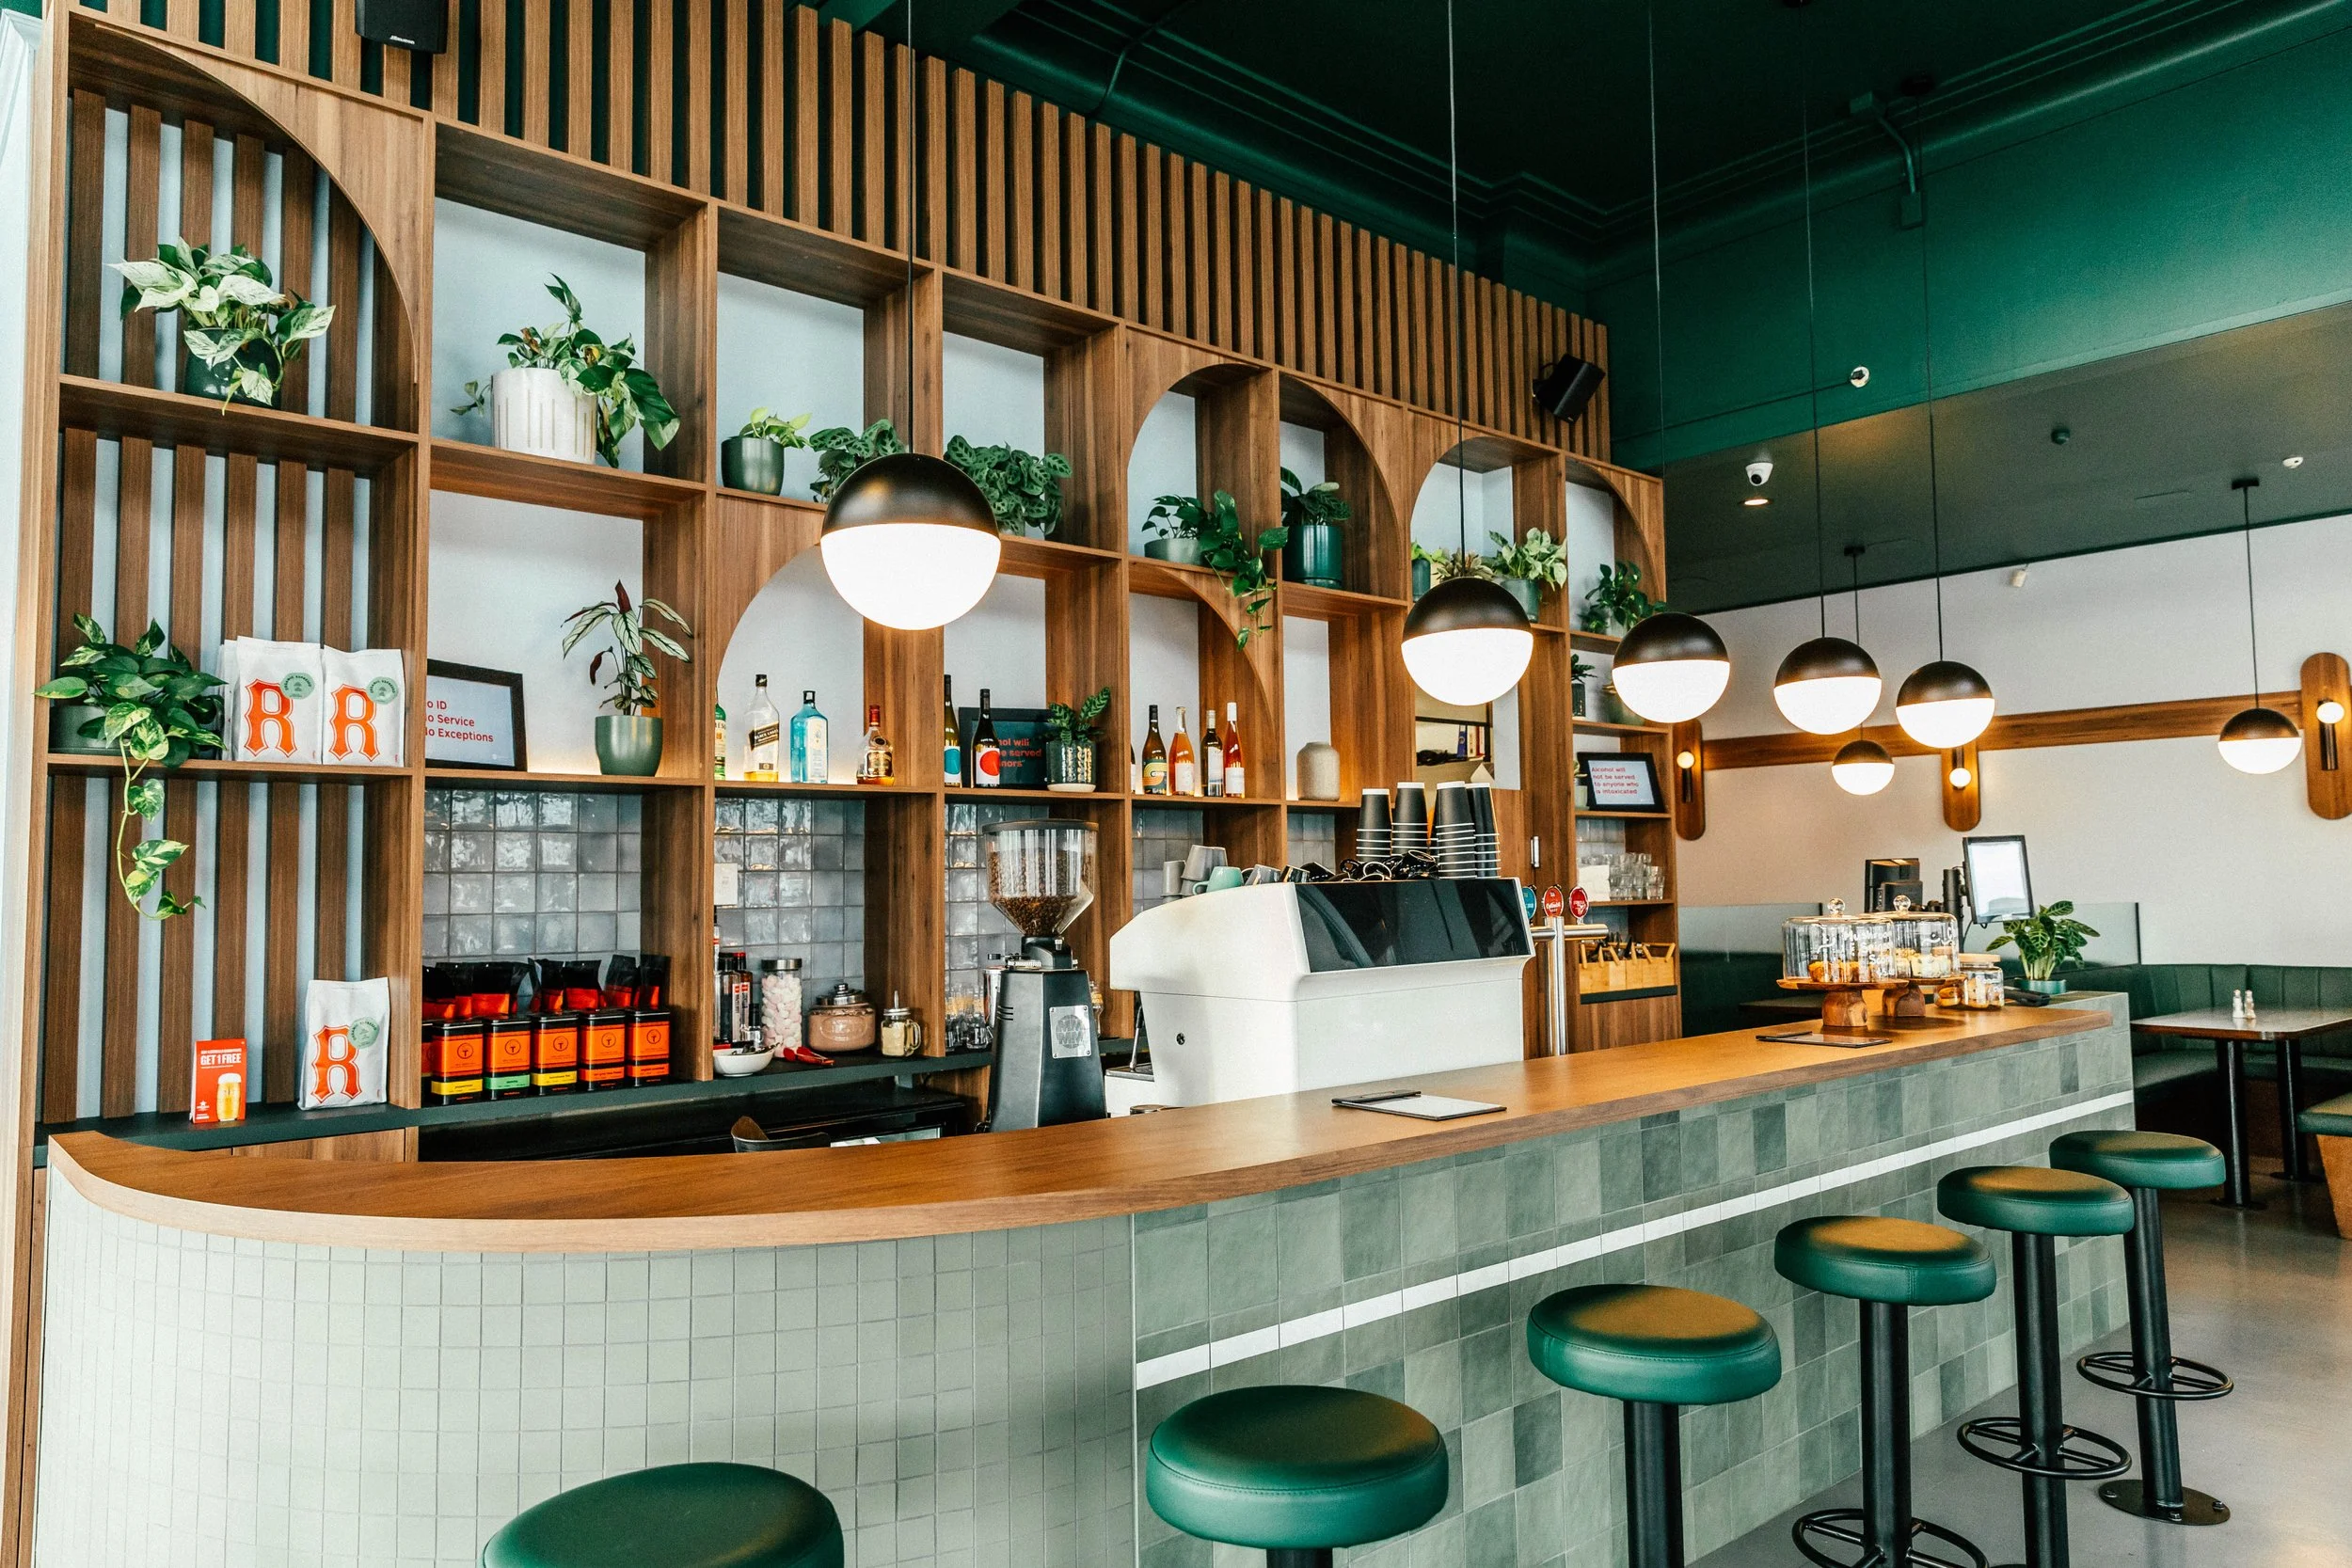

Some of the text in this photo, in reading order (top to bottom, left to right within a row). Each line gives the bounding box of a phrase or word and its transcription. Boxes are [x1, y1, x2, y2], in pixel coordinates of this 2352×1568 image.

[437, 700, 447, 710] ID
[244, 678, 297, 757] R
[329, 683, 380, 762] R
[437, 714, 475, 727] Service
[425, 727, 494, 742] o Exceptions
[1009, 748, 1042, 757] served
[200, 1053, 242, 1066] GET 1 FREE
[310, 1024, 362, 1104] R
